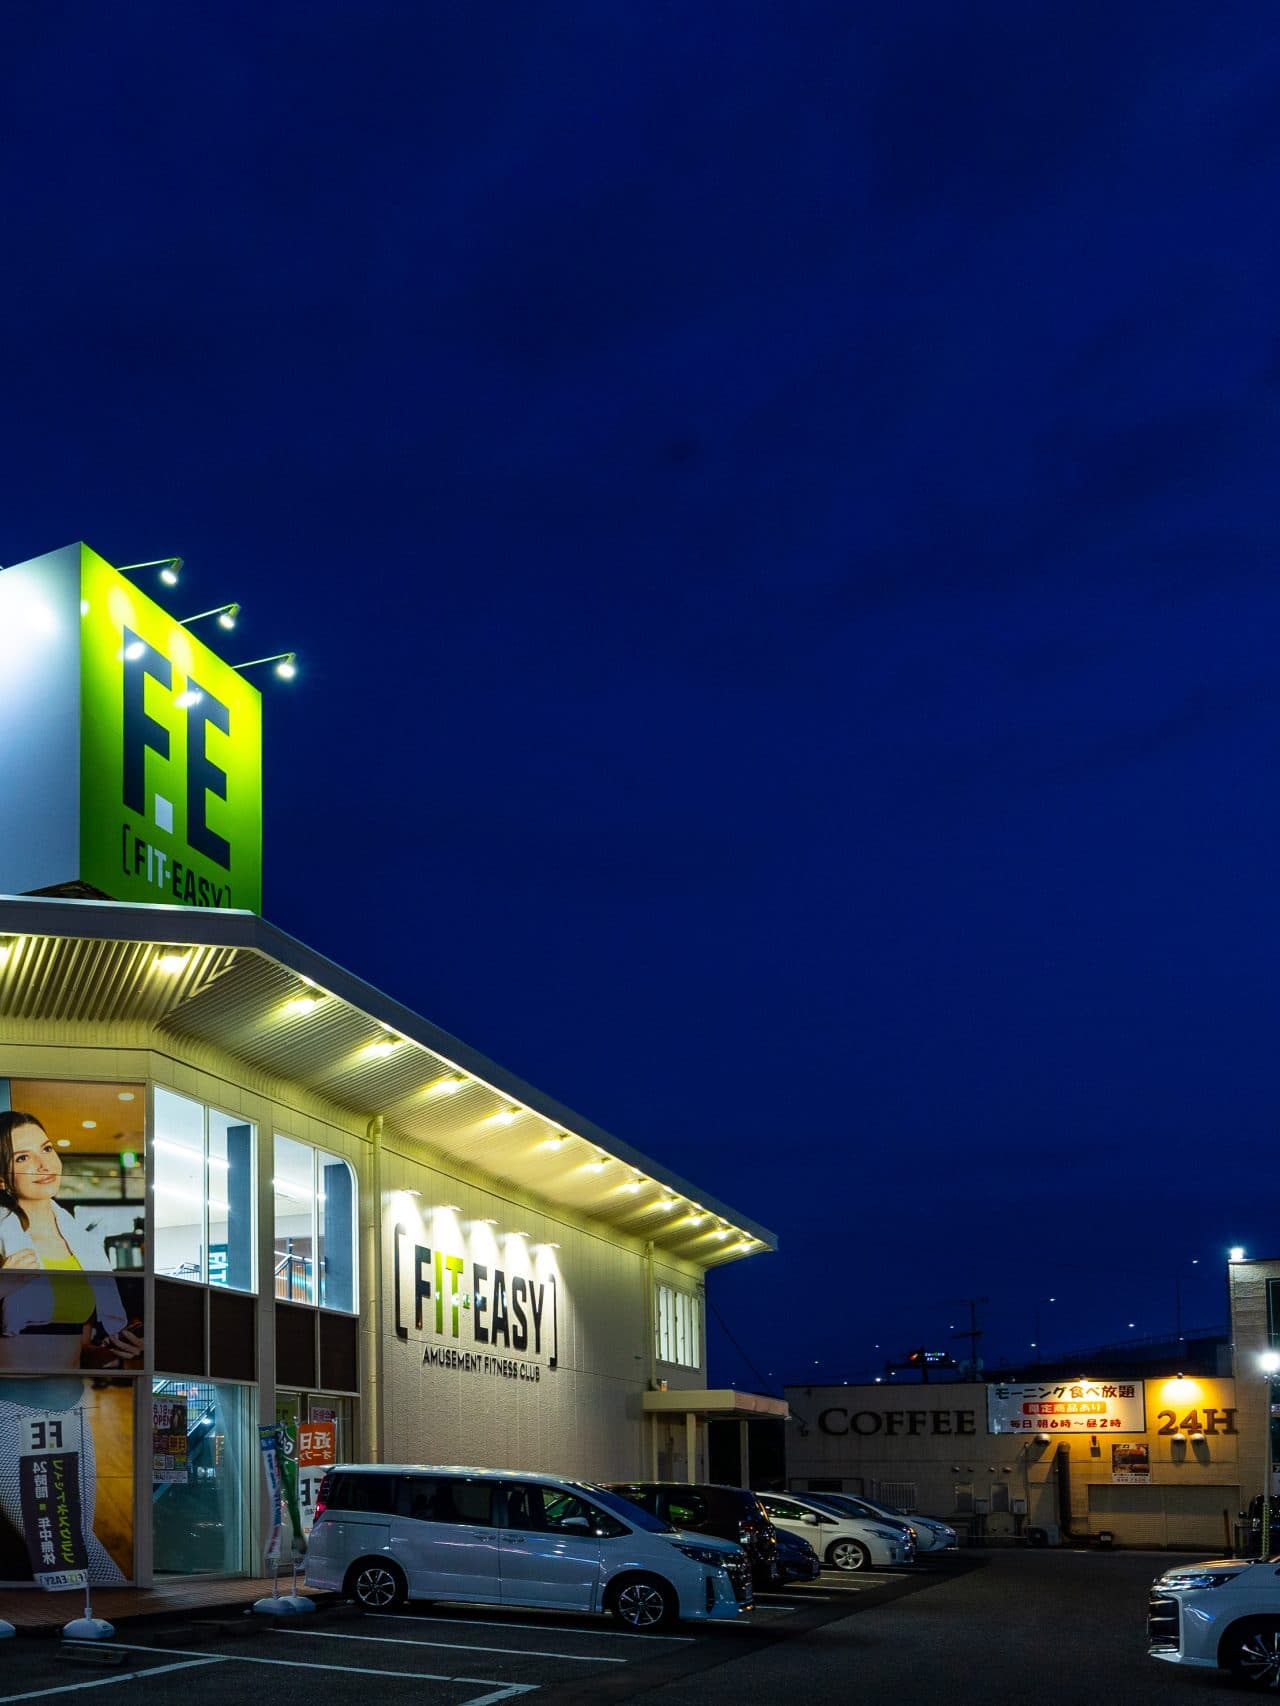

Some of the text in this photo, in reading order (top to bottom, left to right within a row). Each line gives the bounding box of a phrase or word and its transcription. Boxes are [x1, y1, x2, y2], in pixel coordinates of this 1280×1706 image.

[422, 1347, 540, 1382] AMUSEMENT FITNESS CLUB
[818, 1407, 977, 1436] COFFEE
[1157, 1408, 1240, 1435] 24H
